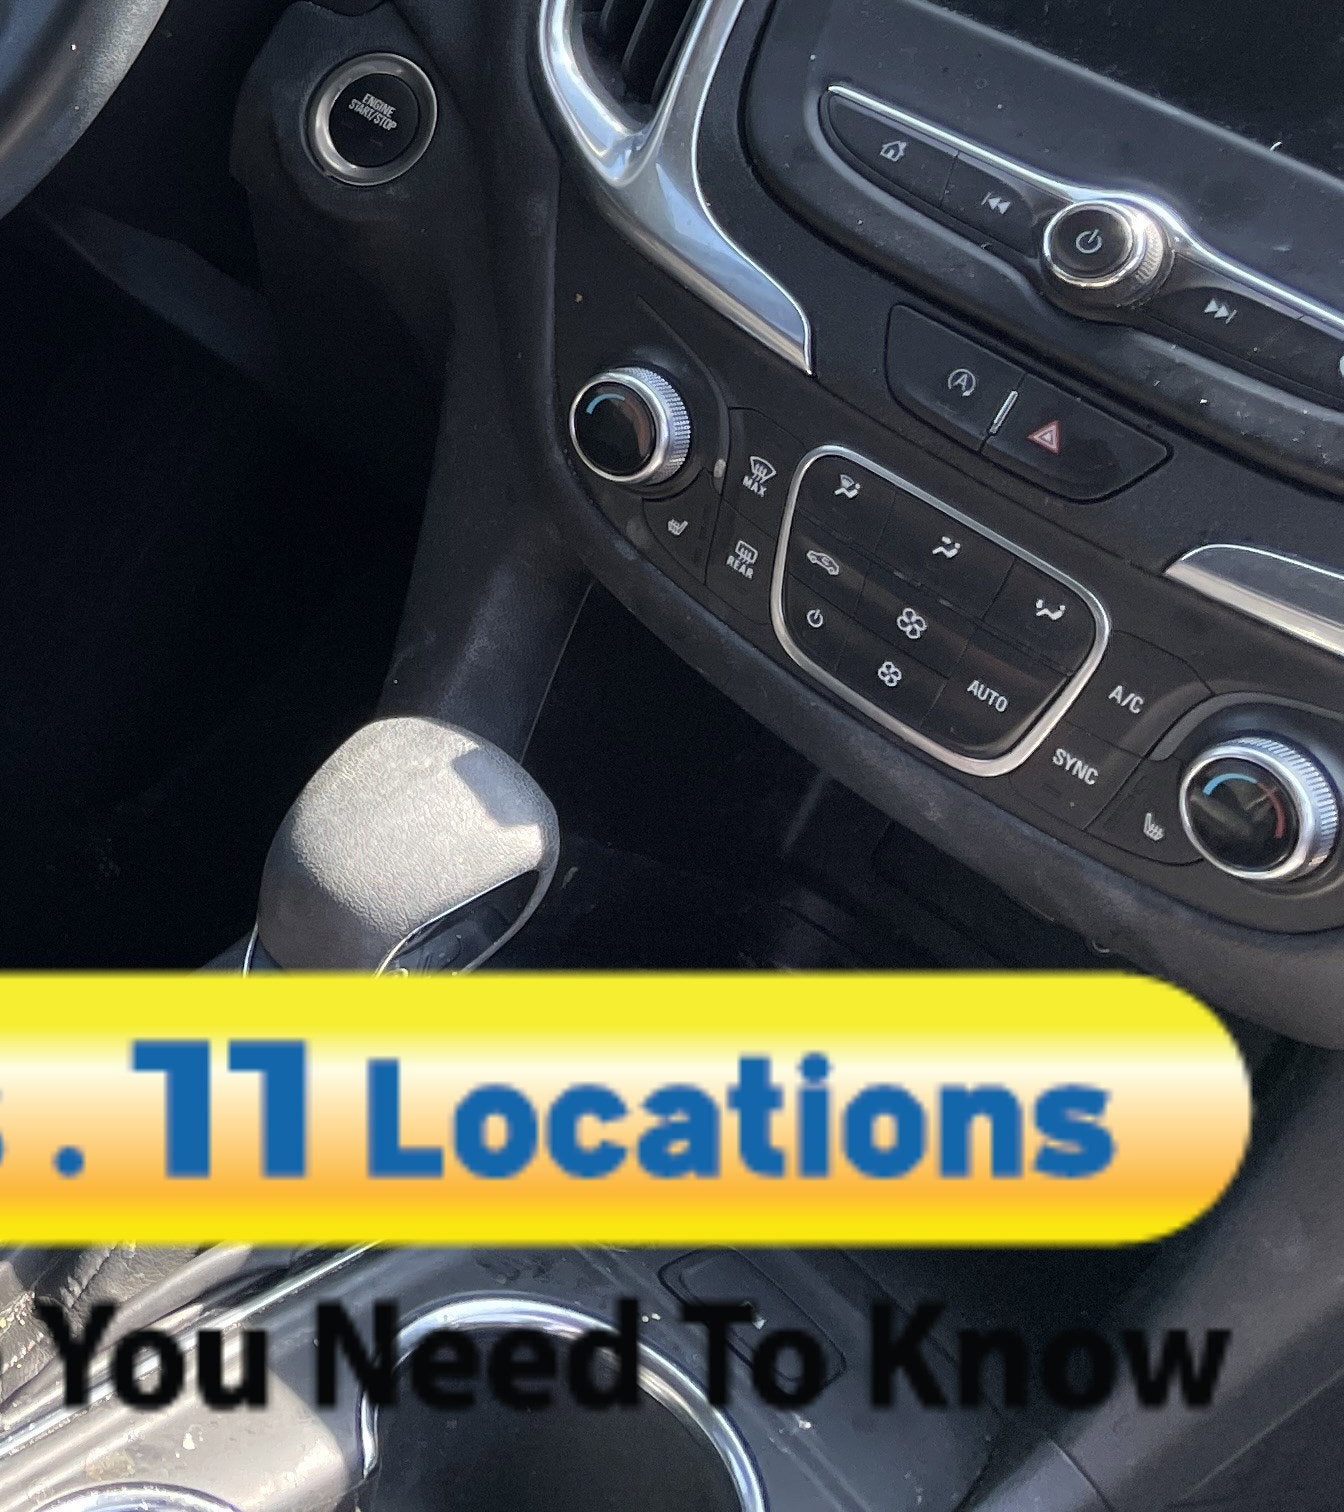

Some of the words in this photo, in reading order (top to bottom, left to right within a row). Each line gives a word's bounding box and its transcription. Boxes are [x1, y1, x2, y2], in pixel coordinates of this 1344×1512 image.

[348, 99, 397, 130] START/STOP
[362, 93, 396, 118] ENGINE
[742, 475, 767, 498] MAX
[726, 555, 755, 581] REAR
[966, 679, 1009, 713] AUTO
[1108, 685, 1145, 715] A/C
[1052, 748, 1100, 786] SYNC
